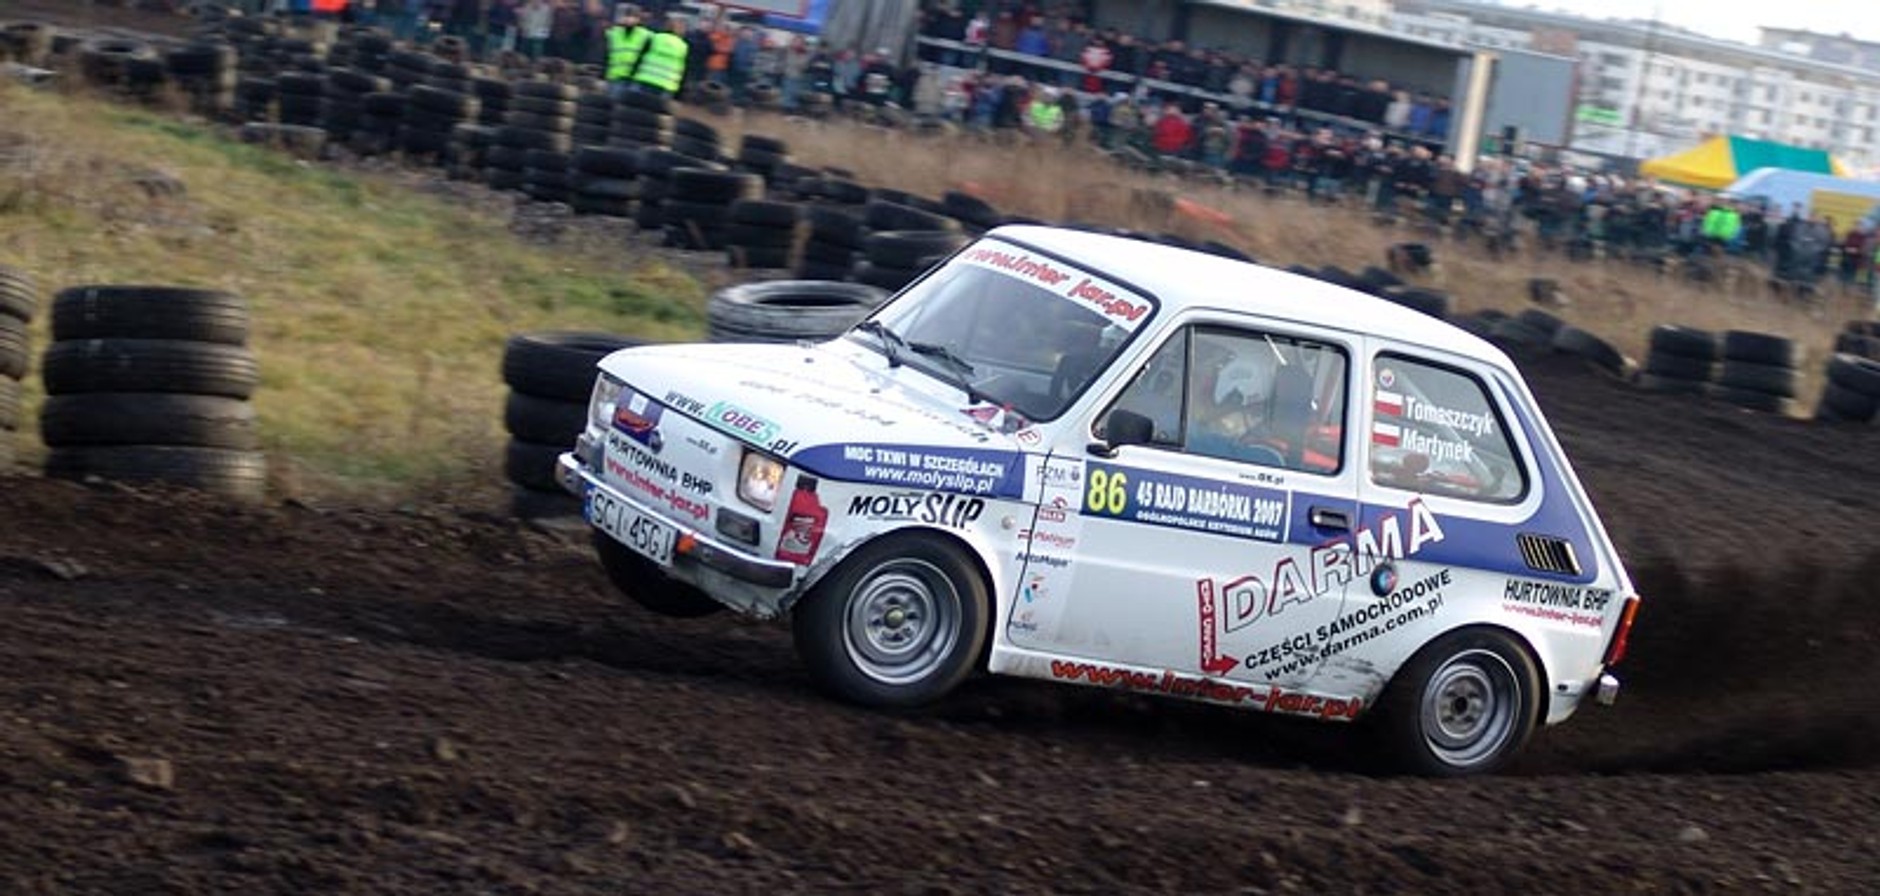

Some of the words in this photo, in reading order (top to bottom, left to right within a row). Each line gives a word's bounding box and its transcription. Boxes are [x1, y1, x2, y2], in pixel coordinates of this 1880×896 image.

[1405, 395, 1493, 437] Tomaszczyk
[609, 432, 678, 483] HURTOWNIA
[682, 471, 713, 496] BHP
[844, 445, 873, 462] MOC
[876, 448, 906, 466] TKWI
[909, 453, 922, 467] W
[923, 454, 1005, 478] SZCZEGÓŁACH
[1402, 428, 1473, 462] Martynek
[865, 466, 995, 492] www.molyslip.pl
[1088, 469, 1127, 514] 86
[1136, 480, 1153, 508] 45
[1154, 482, 1186, 511] RAJD
[1187, 484, 1251, 522] BARBÓRKA
[1253, 498, 1284, 527] 2007
[630, 515, 671, 561] 45GJ
[1222, 496, 1445, 634] DARMA
[1244, 632, 1312, 670] CZĘŚCI
[1316, 568, 1452, 640] SAMOCHODOWE
[1504, 577, 1581, 609] HURTOWNIA
[1583, 588, 1611, 611] BHP
[1264, 593, 1443, 680] www.darma.com.pl
[1052, 659, 1363, 720] www.inter-jar.pl
